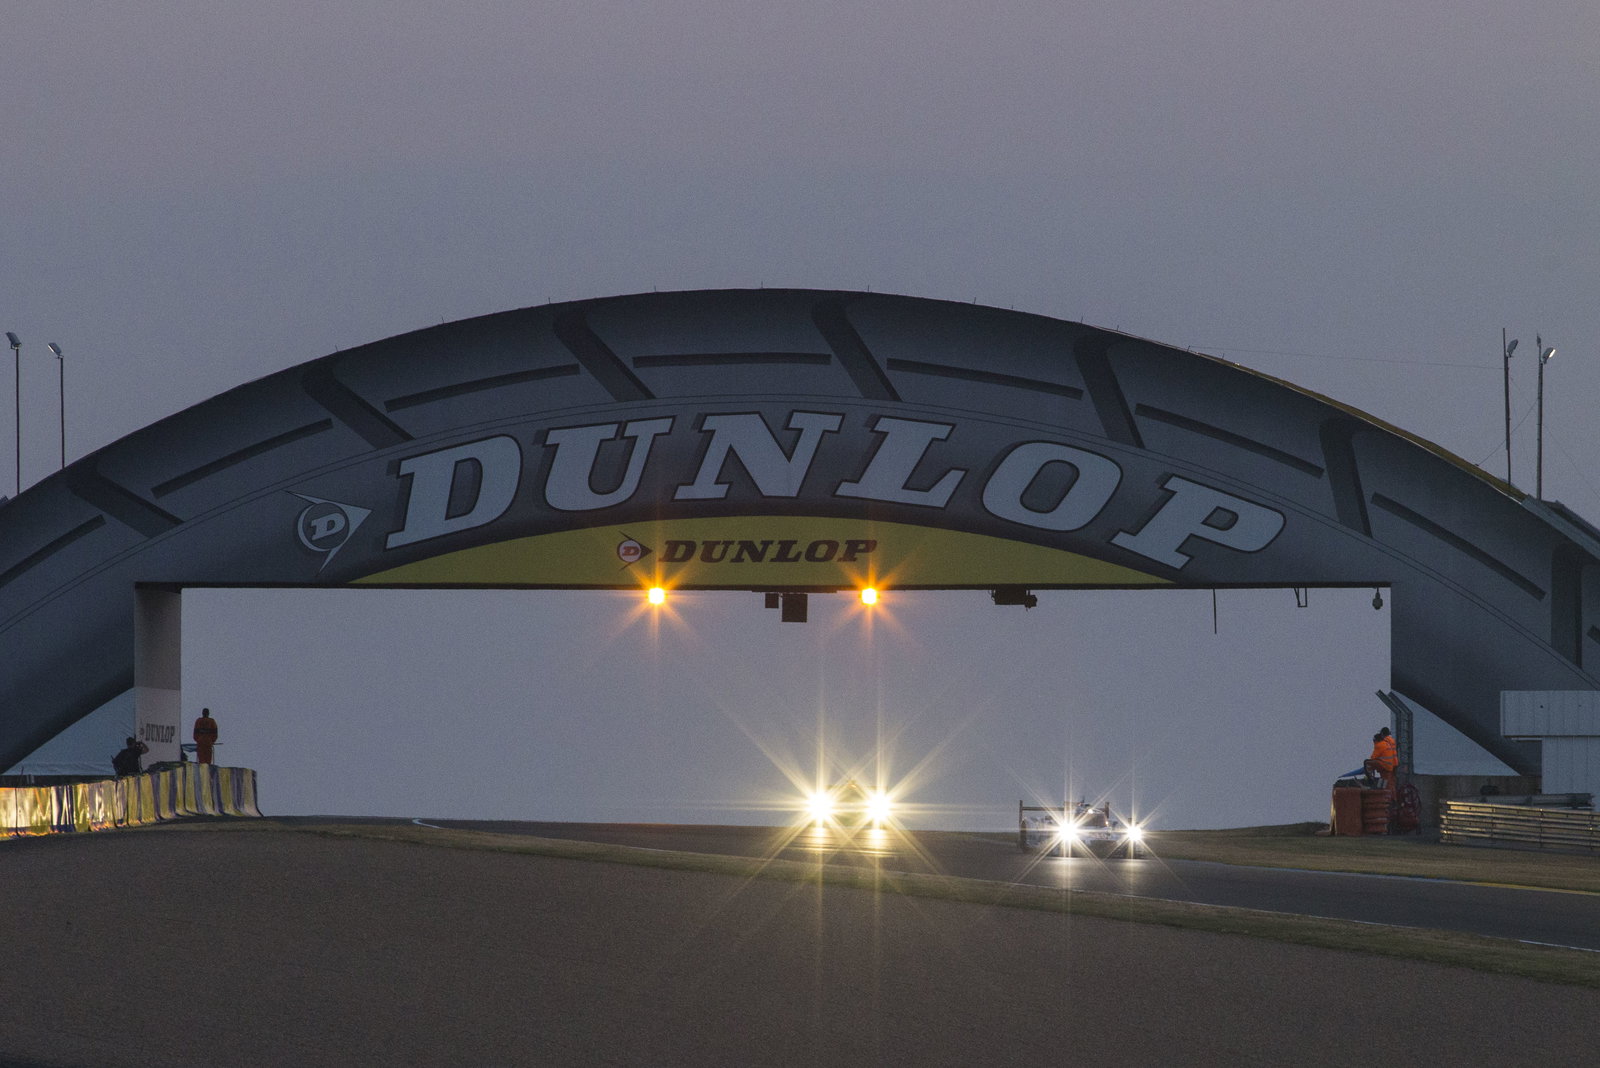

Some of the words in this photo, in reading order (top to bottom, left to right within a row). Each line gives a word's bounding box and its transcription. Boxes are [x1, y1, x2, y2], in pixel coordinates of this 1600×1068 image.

[310, 512, 346, 541] D
[385, 411, 1285, 569] DUNLOP
[658, 540, 877, 563] DUNLOP
[145, 723, 175, 743] DUNLOP
